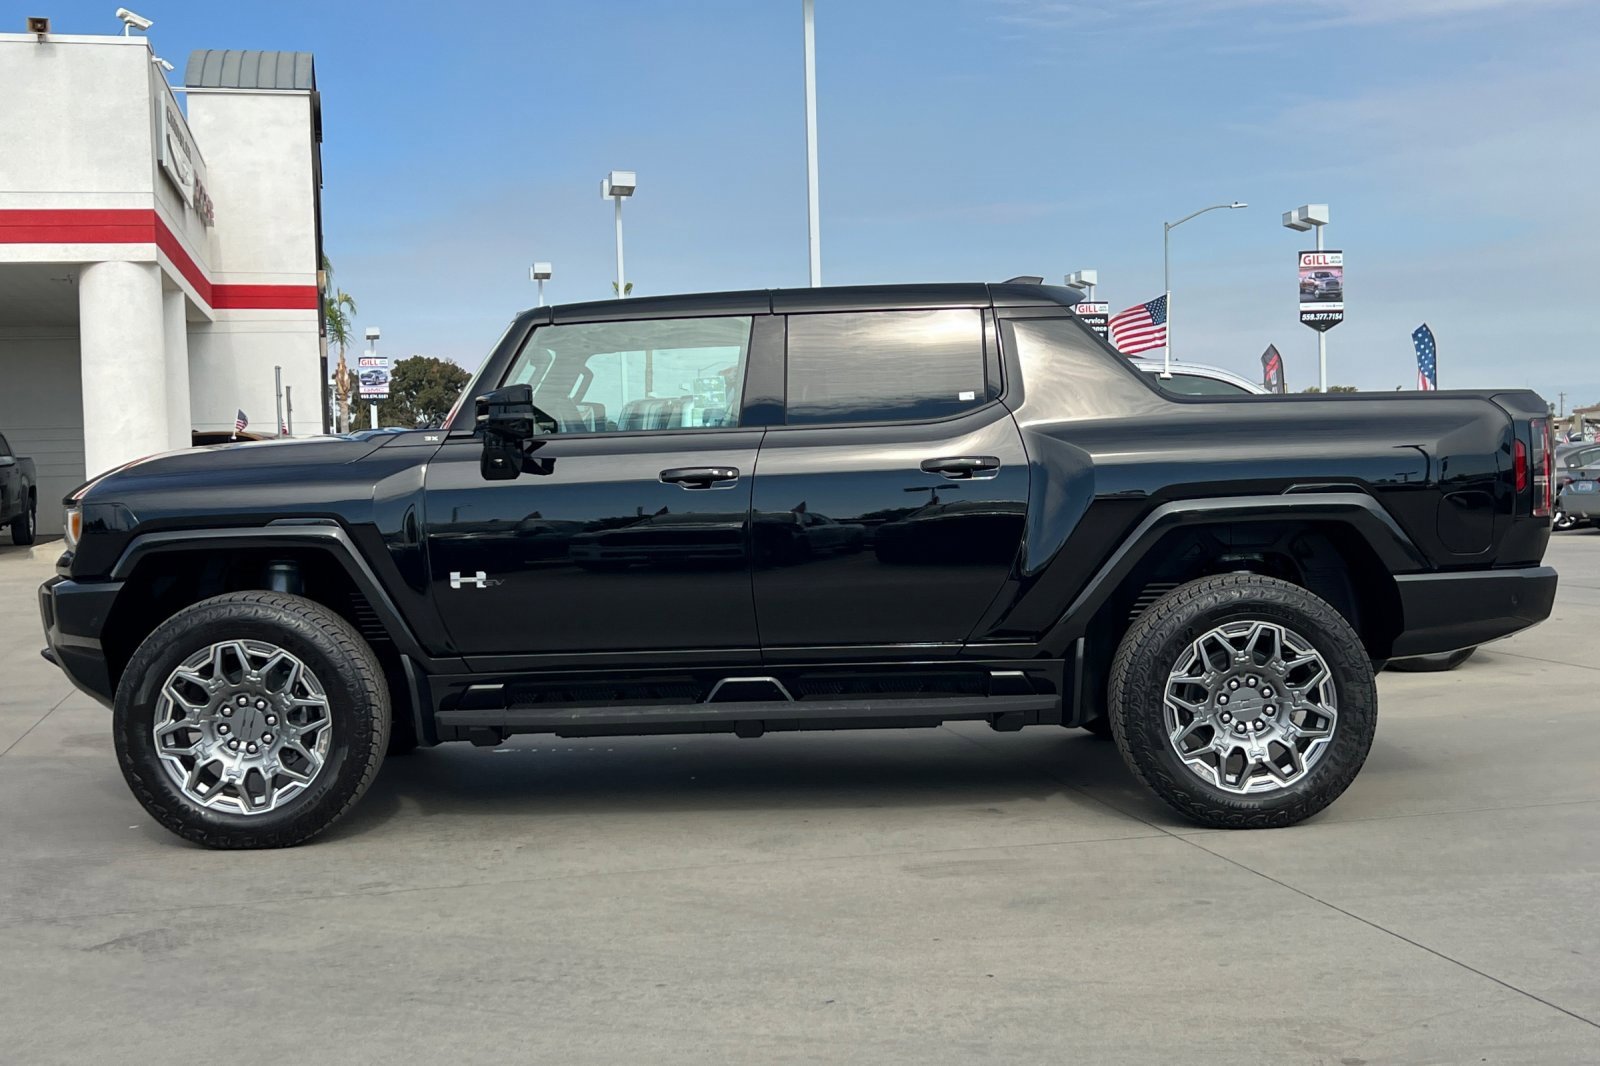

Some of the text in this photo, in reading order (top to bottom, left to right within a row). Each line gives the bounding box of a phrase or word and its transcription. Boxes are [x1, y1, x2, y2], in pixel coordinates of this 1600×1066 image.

[1303, 255, 1329, 266] GILL
[1078, 305, 1098, 313] GILL
[1301, 313, 1343, 321] 559.377.7154
